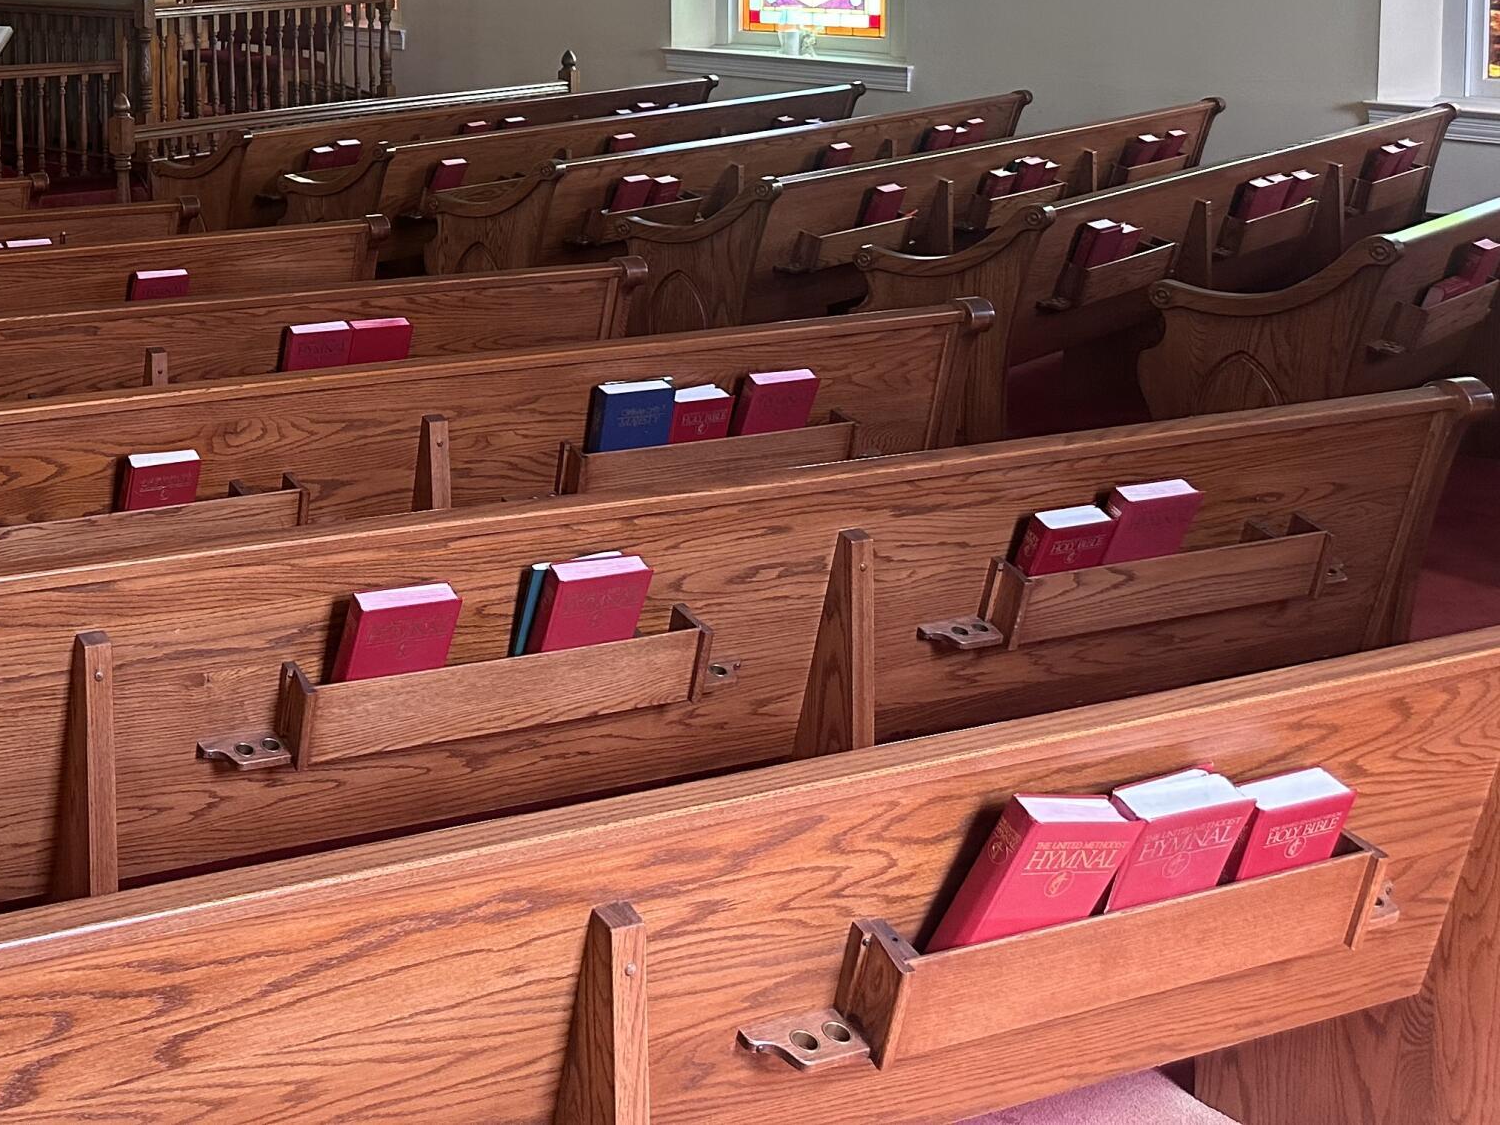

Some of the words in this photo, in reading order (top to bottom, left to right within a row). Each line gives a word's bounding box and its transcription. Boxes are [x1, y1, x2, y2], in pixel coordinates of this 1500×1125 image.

[1138, 825, 1233, 862] HYMNAL
[1266, 825, 1302, 845] HOLY
[1302, 817, 1339, 836] BIBLE
[1024, 849, 1119, 870] HYMNAL
